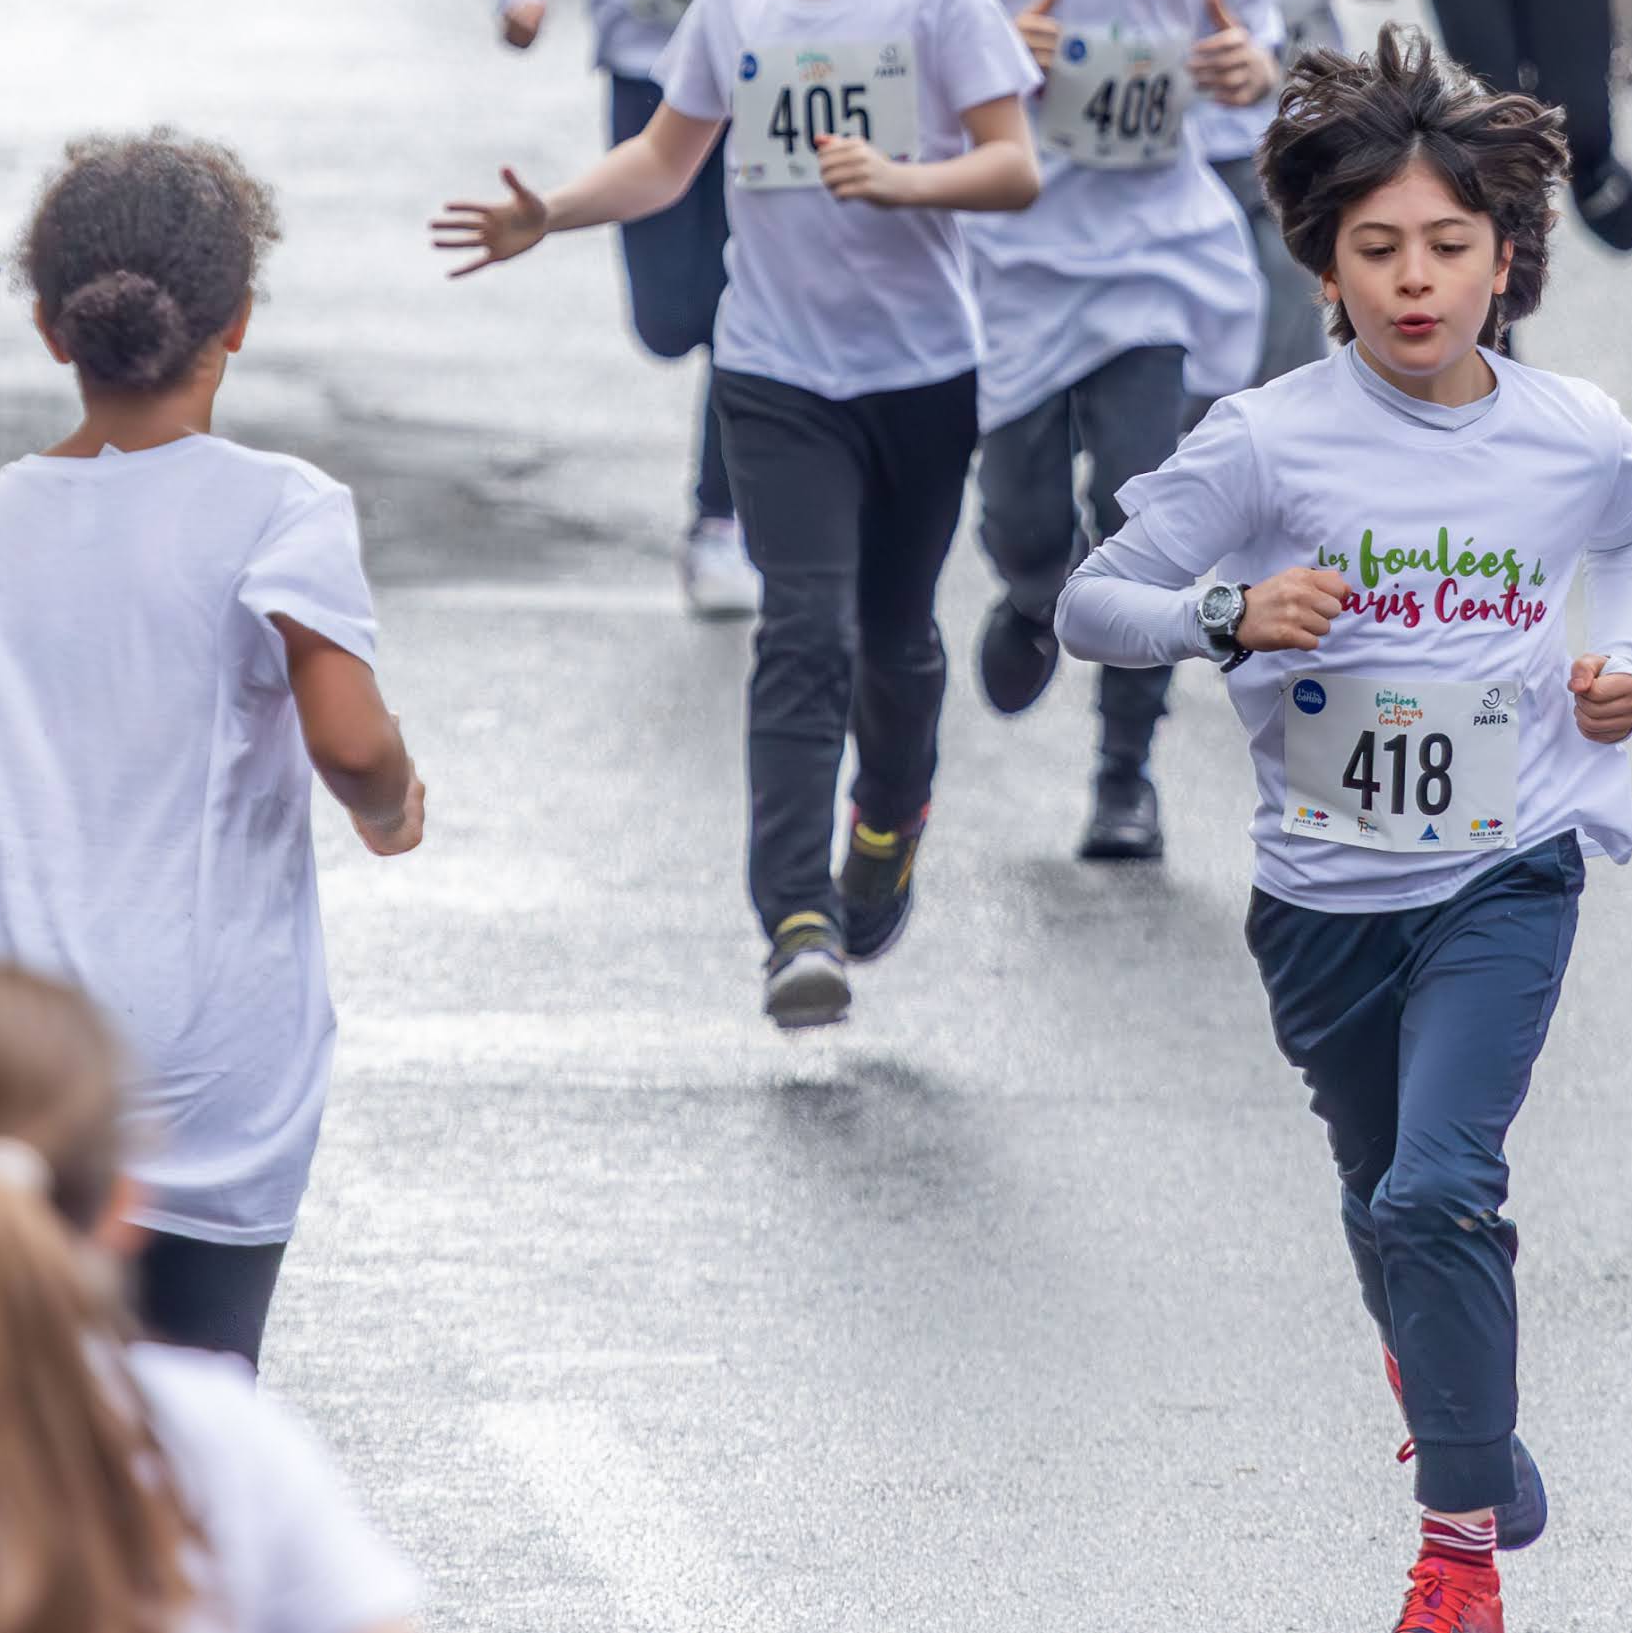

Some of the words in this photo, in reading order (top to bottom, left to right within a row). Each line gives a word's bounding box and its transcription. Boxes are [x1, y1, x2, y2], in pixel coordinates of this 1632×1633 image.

[769, 84, 871, 154] 405
[1084, 72, 1171, 138] 408
[1360, 526, 1524, 591] foulées
[1339, 582, 1424, 629] aris
[1435, 577, 1548, 632] Centre
[1473, 713, 1509, 726] PARIS
[1342, 729, 1453, 816] 418
